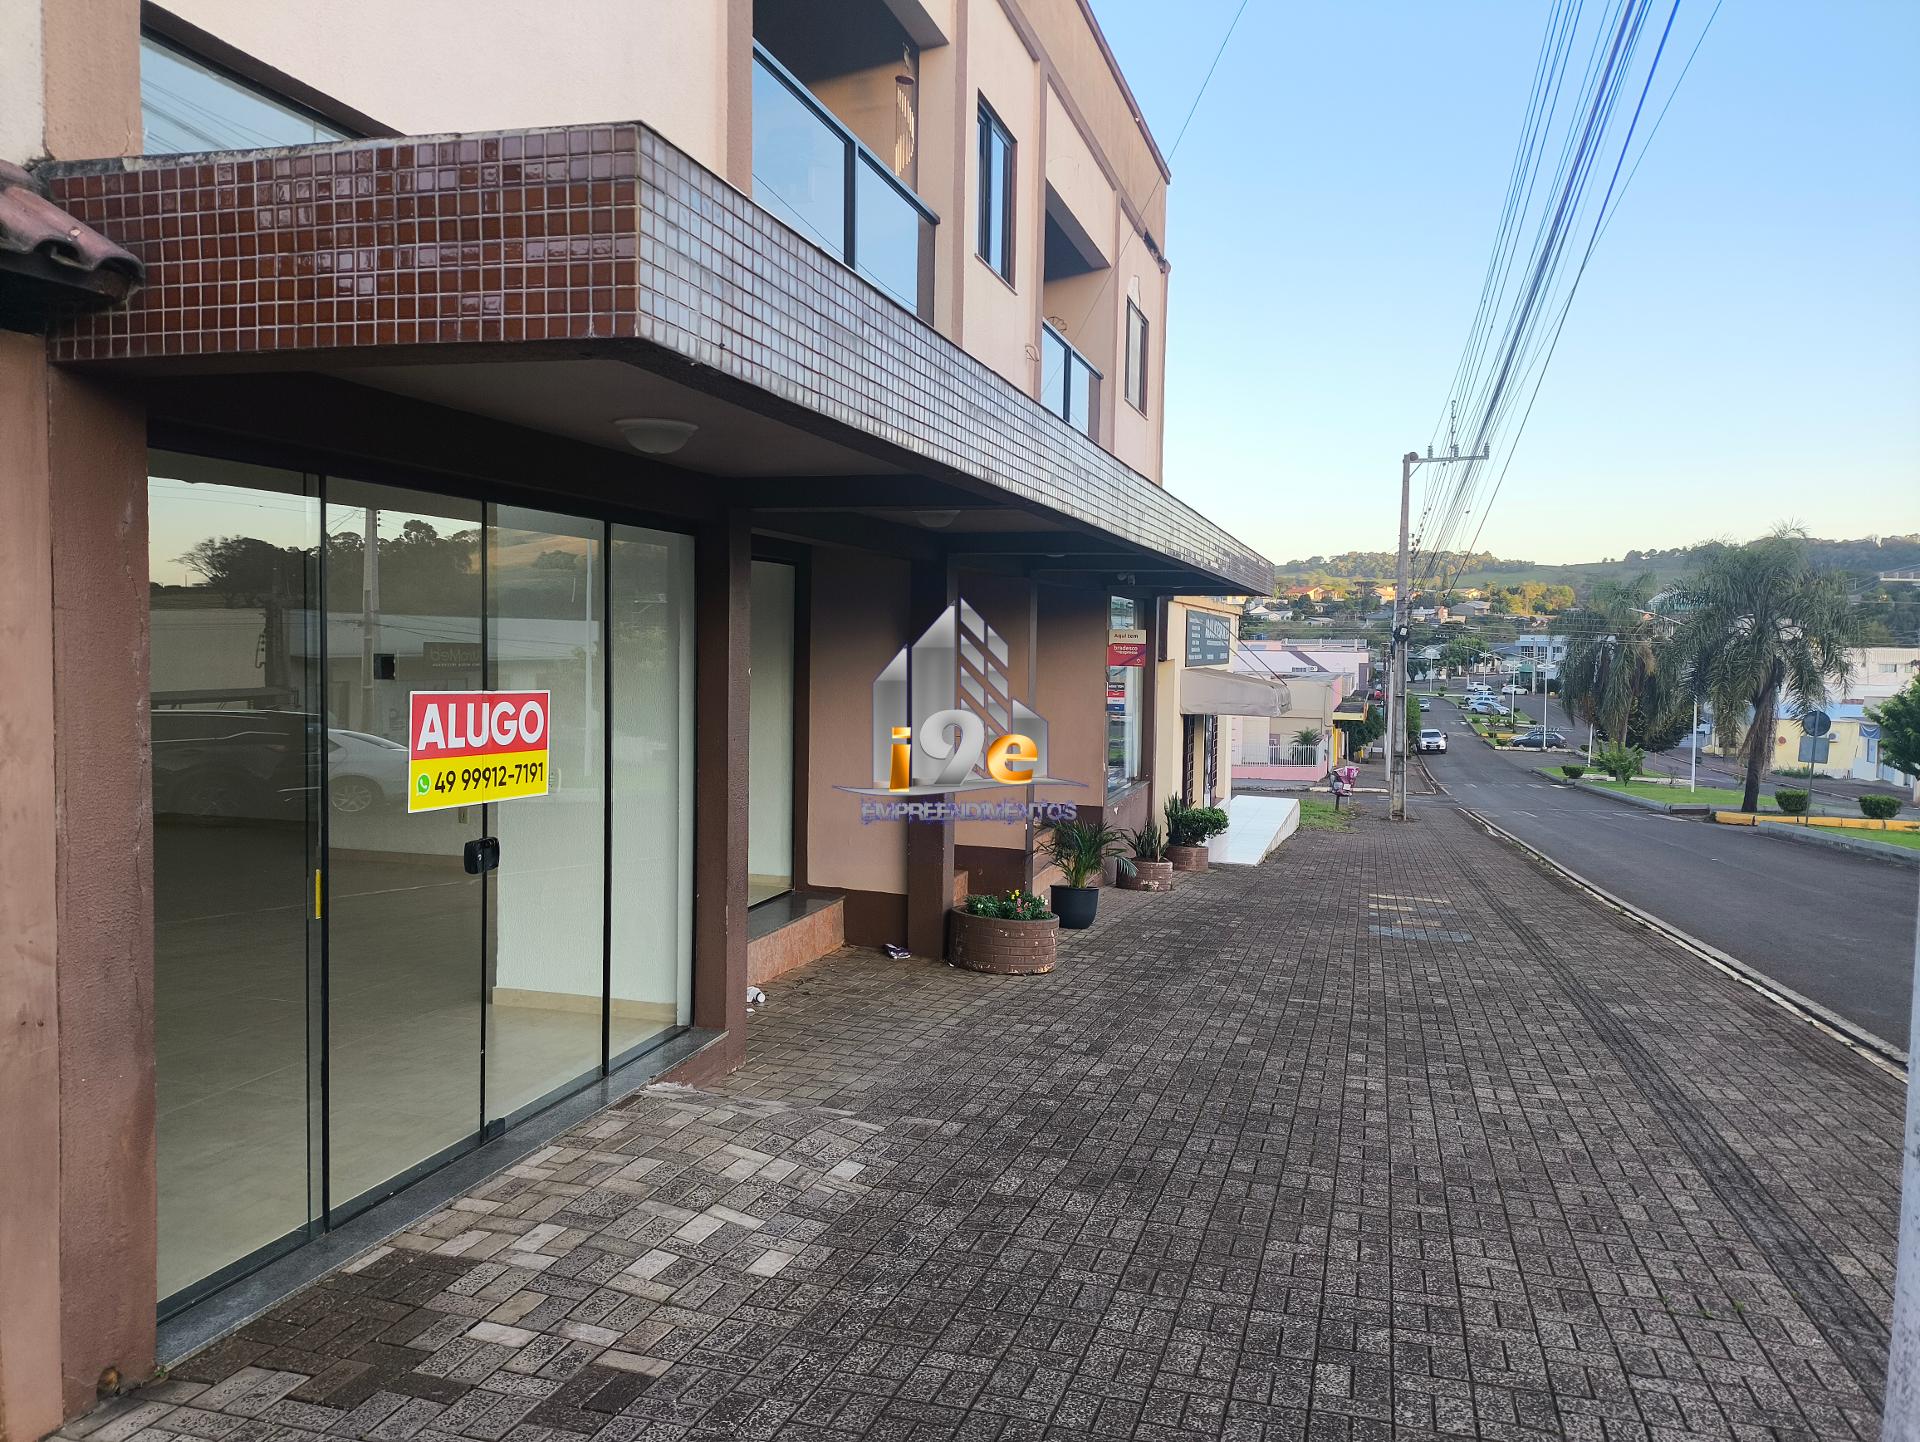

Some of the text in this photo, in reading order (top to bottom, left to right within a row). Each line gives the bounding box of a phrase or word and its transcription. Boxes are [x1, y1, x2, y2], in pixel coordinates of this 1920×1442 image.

[416, 700, 545, 751] ALUGO
[434, 761, 544, 794] 49 99912-7191
